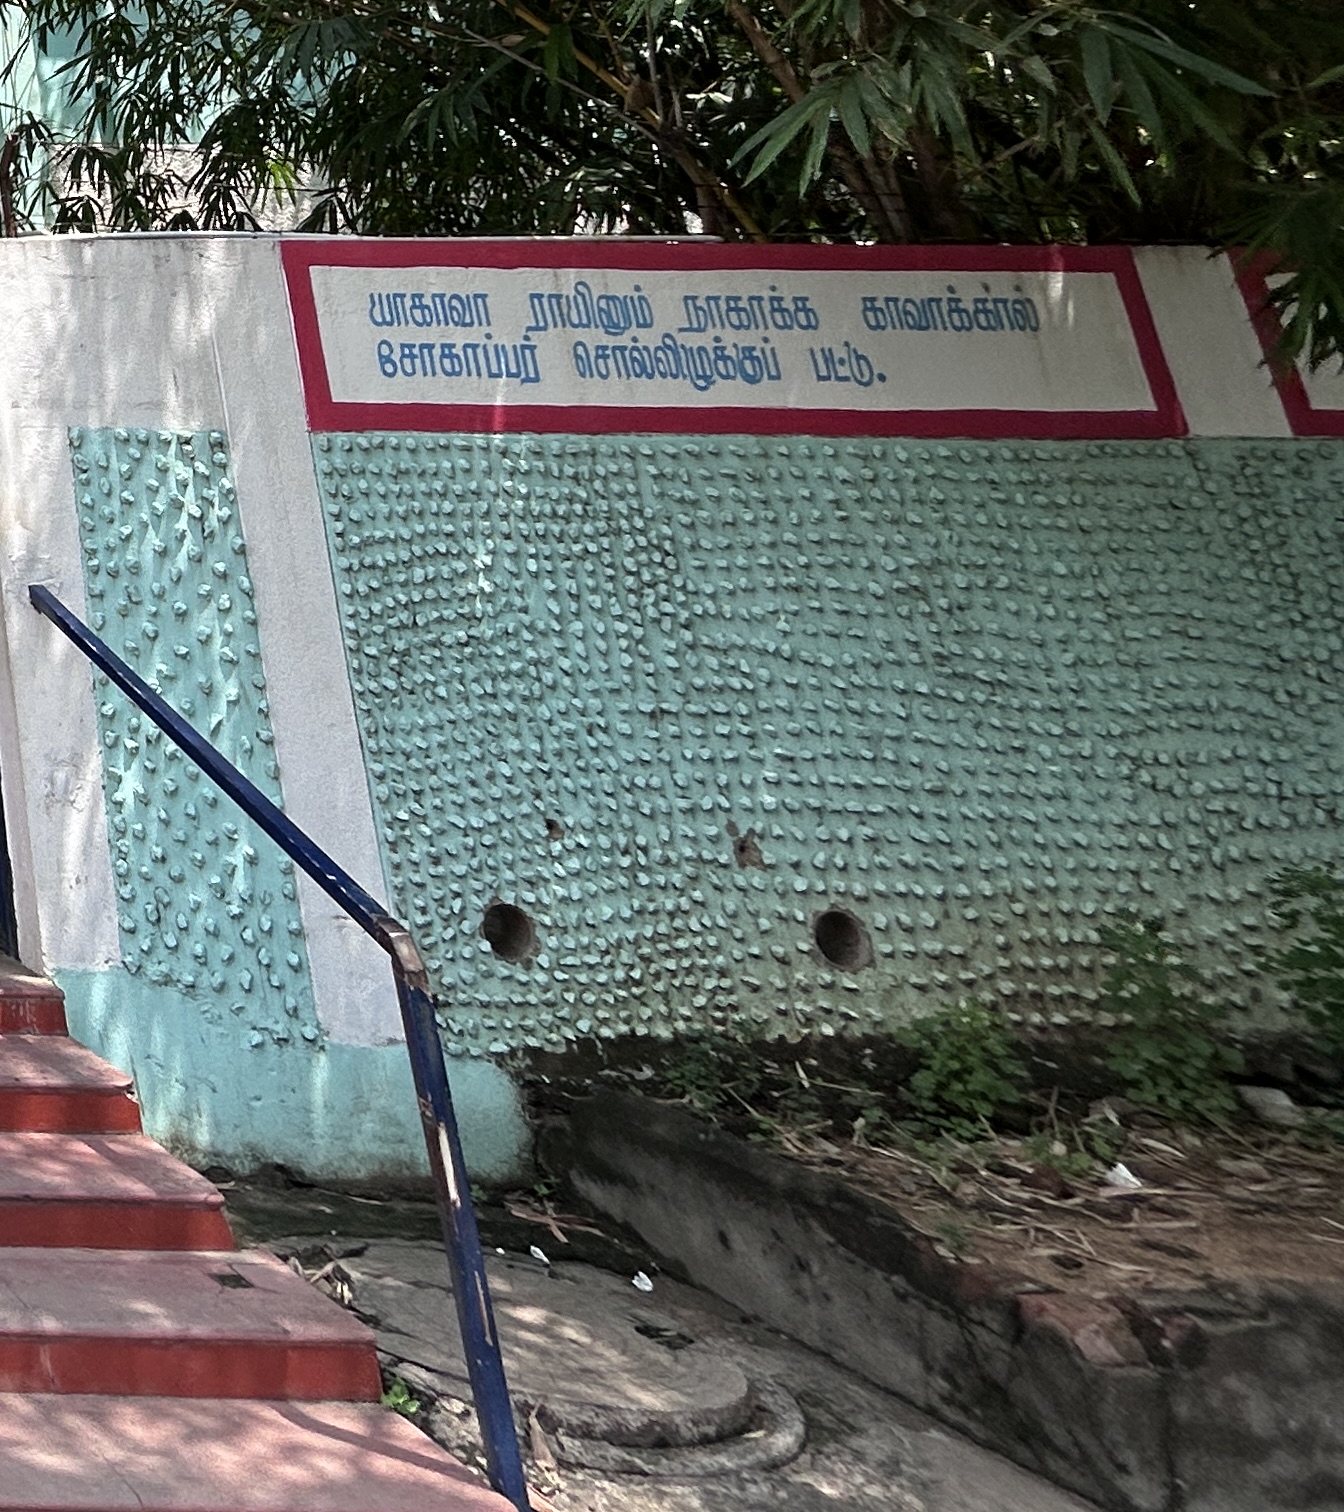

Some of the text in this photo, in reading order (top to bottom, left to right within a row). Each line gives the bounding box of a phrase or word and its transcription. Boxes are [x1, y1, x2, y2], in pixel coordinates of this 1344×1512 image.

[368, 291, 492, 329] யாகாவா
[678, 285, 819, 334] நாகாக்க
[377, 333, 541, 384] சோகாப்பர்
